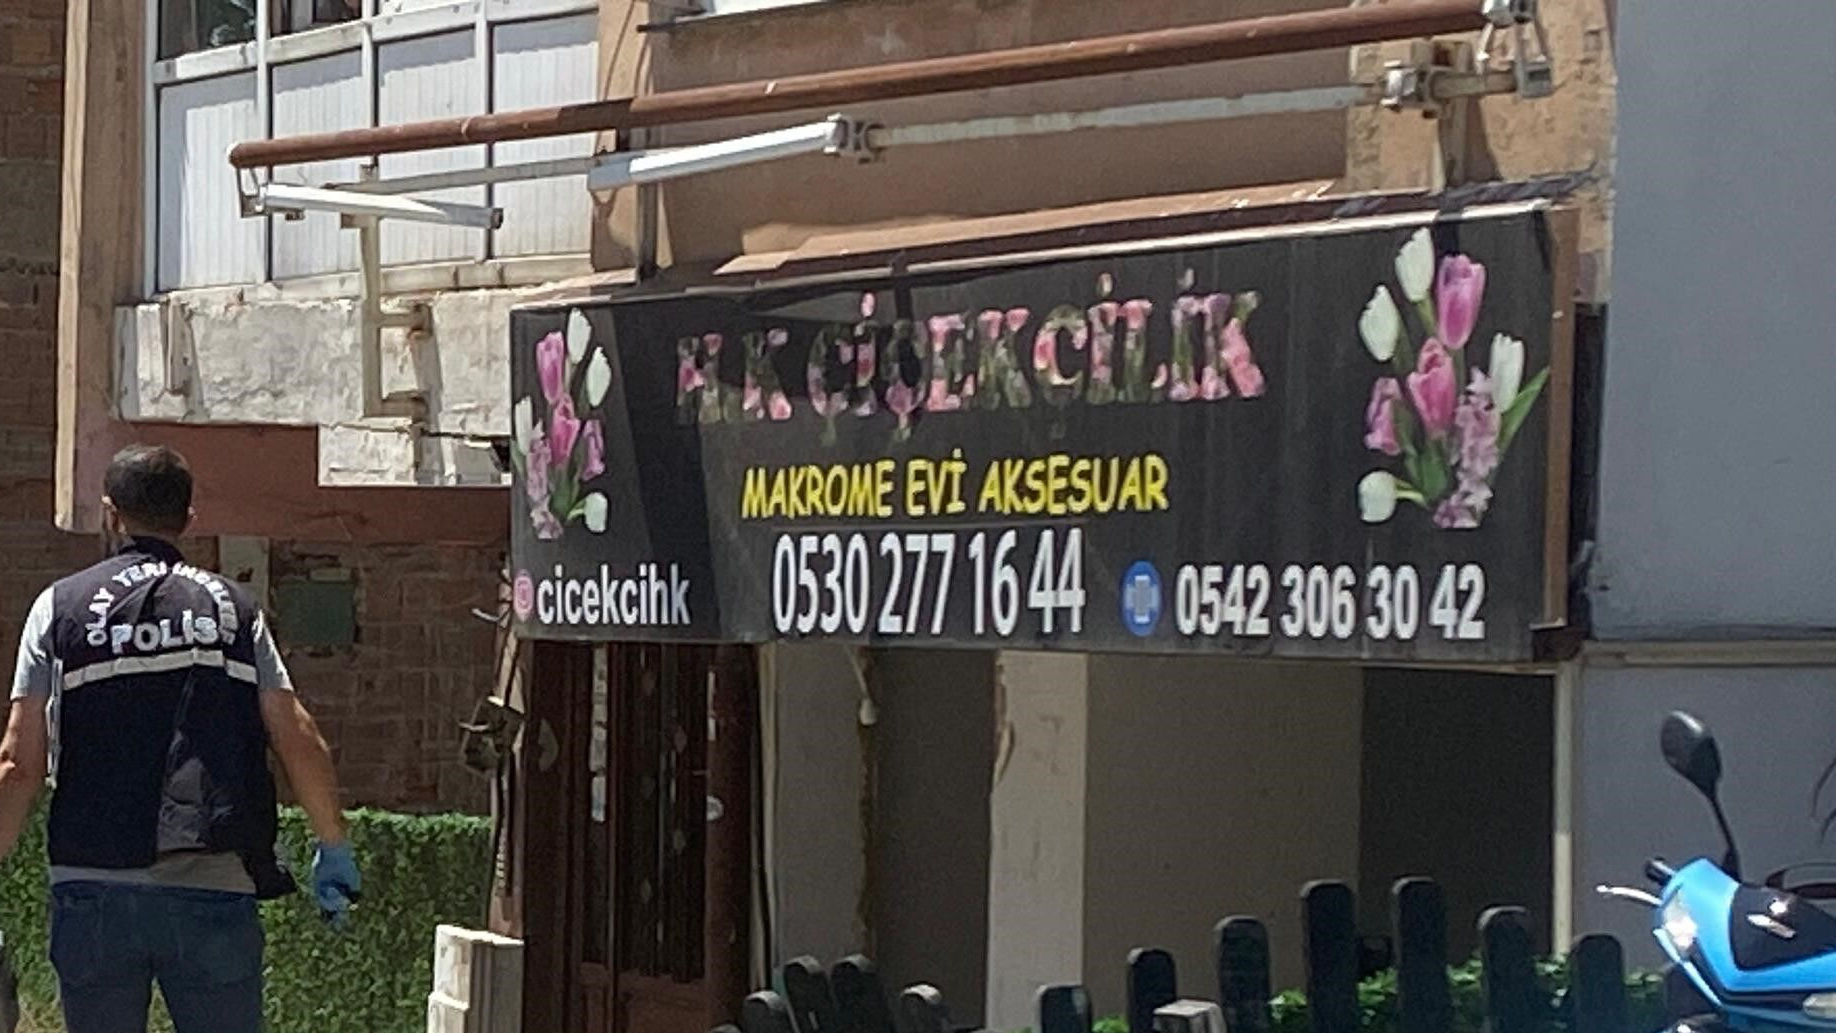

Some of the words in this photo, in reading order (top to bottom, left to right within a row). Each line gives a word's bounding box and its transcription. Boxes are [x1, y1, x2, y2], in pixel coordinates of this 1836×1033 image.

[741, 460, 895, 518] MAKROME
[905, 448, 967, 516] EVİ
[978, 454, 1169, 516] AKSESUAR
[537, 562, 691, 625] cicekcihk
[772, 533, 870, 635] 0530
[877, 531, 956, 635] 277
[968, 528, 1020, 636] 16
[1027, 526, 1086, 635] 44
[1175, 563, 1271, 637] 0542
[1279, 564, 1358, 639] 306
[1365, 564, 1420, 640] 30
[1428, 563, 1486, 640] 42
[84, 587, 115, 646] OLAY
